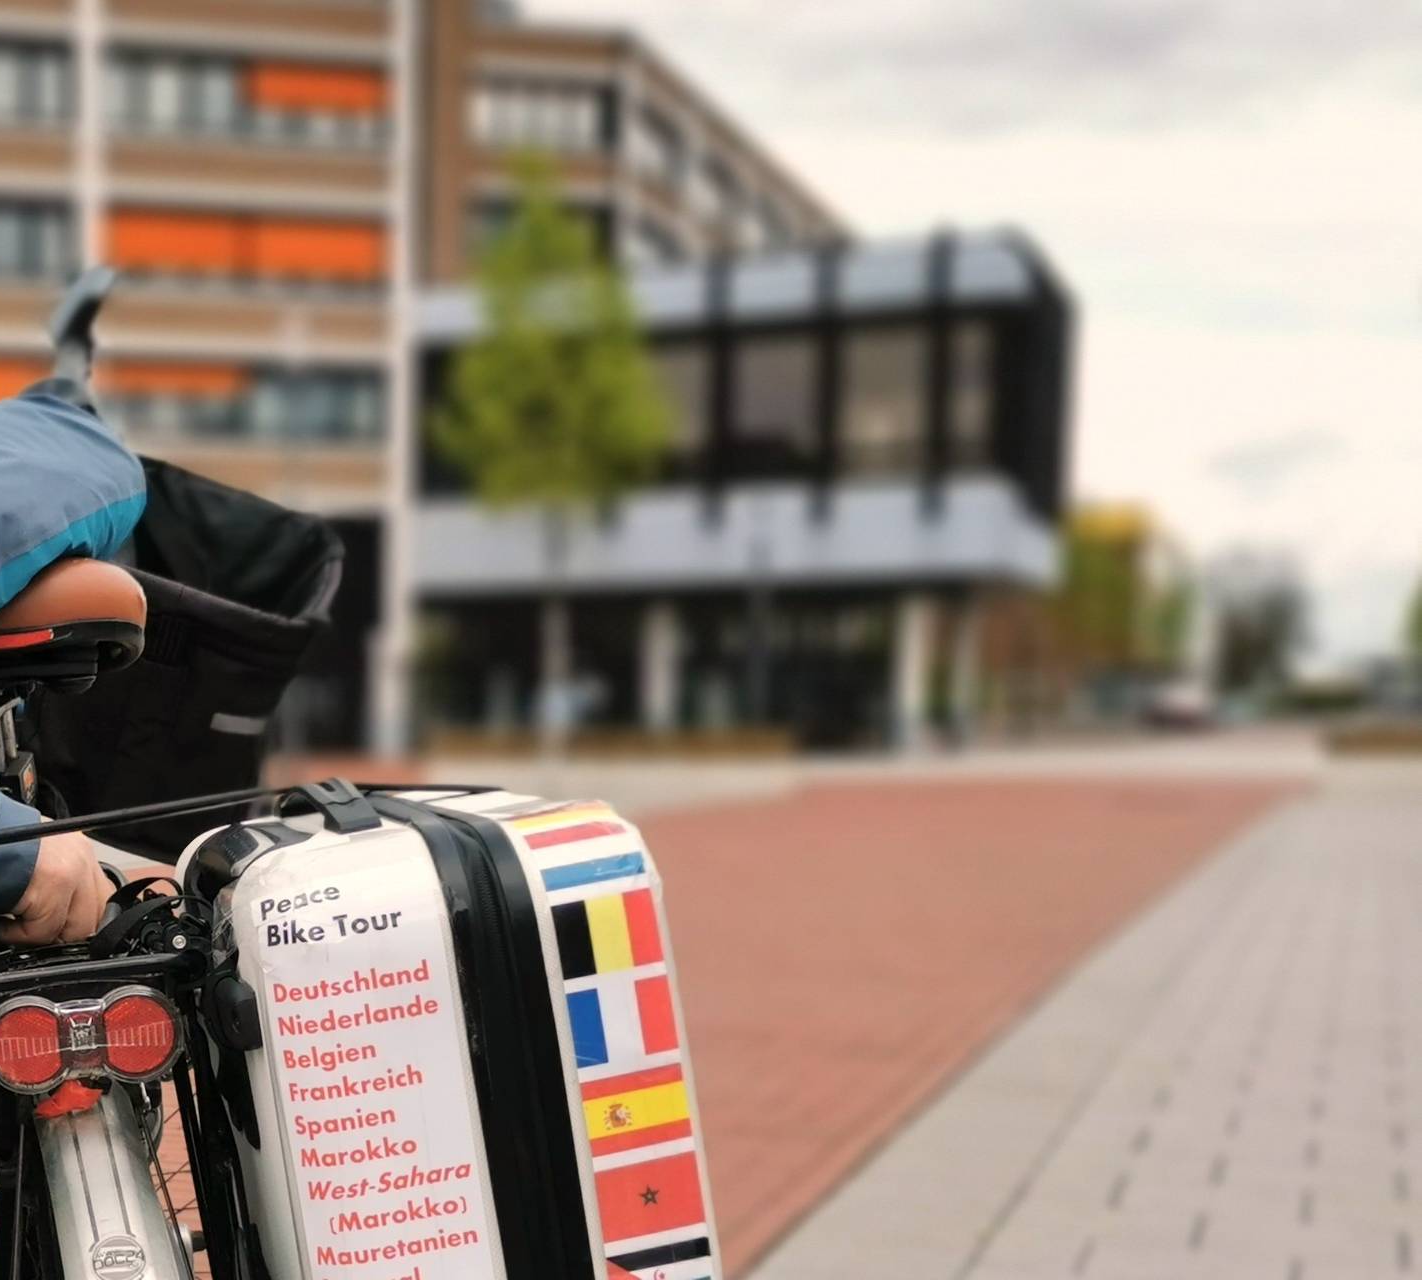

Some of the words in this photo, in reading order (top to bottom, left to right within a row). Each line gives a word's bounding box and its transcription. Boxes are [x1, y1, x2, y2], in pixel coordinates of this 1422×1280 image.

[260, 886, 340, 921] Peace
[266, 920, 325, 946] Bike
[332, 911, 402, 937] Tour
[272, 959, 430, 1003] Deutschland
[278, 995, 438, 1036] Niederlande
[283, 1043, 376, 1072] Belgien
[289, 1065, 423, 1102] Frankreich
[294, 1108, 396, 1140] Spanien
[301, 1137, 417, 1168] Marokko
[307, 1163, 471, 1200] West-Sahara
[329, 1196, 467, 1235] (Marokko)
[317, 1229, 479, 1266] Mauretanien
